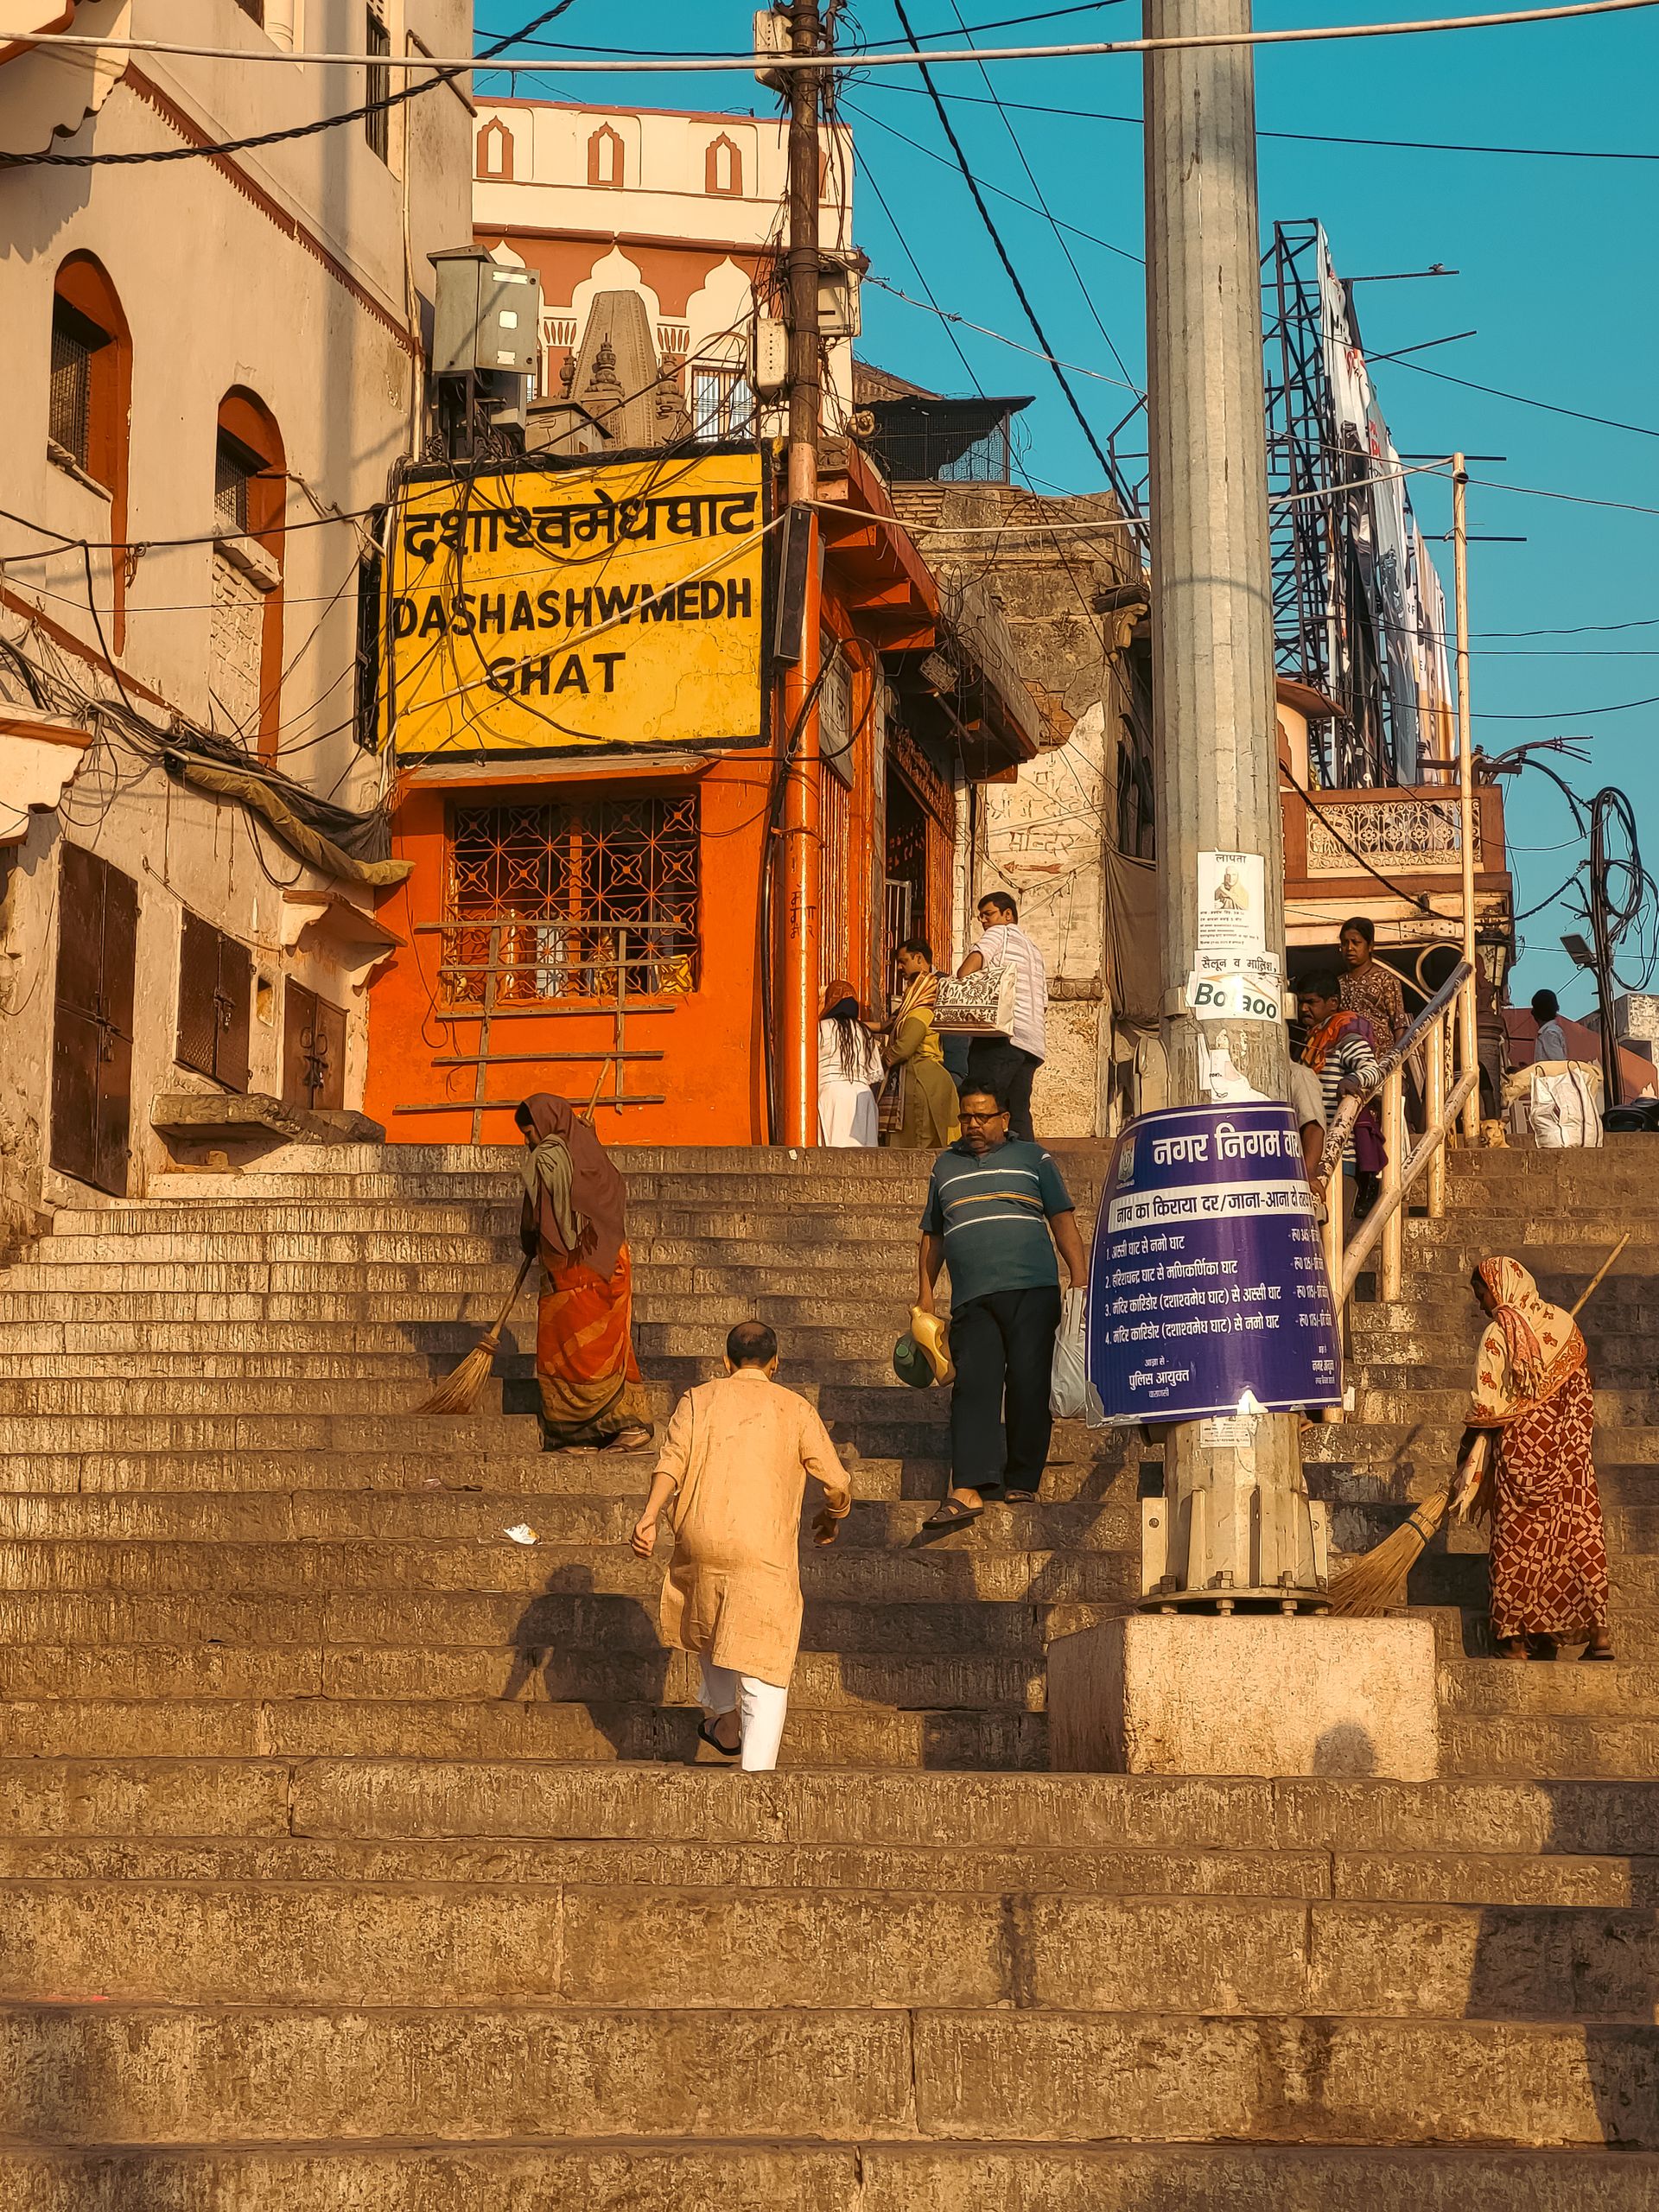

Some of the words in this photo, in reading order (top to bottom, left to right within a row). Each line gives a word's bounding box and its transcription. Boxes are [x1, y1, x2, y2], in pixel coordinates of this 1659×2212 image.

[393, 578, 752, 639] DASHASHWMEDH
[486, 652, 626, 696] GHAT
[1215, 854, 1247, 864] लापता
[1201, 956, 1227, 971] सैलून
[1233, 958, 1241, 968] व
[1153, 1135, 1209, 1165] नगर
[1214, 1122, 1281, 1160] निगम
[1116, 1206, 1133, 1223] नाव
[1135, 1204, 1149, 1219] का
[1153, 1196, 1197, 1217] किराया
[1106, 1248, 1110, 1261] 1.
[1111, 1239, 1127, 1259] अस्सी
[1128, 1242, 1140, 1256] घाट
[1141, 1236, 1149, 1254] से
[1150, 1233, 1167, 1252] नमो
[1169, 1236, 1185, 1250] घाट
[1105, 1276, 1111, 1288] 2.
[1141, 1268, 1155, 1282] घाट
[1157, 1262, 1164, 1280] से
[1166, 1258, 1218, 1279] मणिकर्णिका
[1221, 1261, 1237, 1274] घाट
[1105, 1304, 1111, 1317] 3.
[1113, 1297, 1128, 1315] मंदिर
[1207, 1287, 1229, 1305] घाट)
[1231, 1285, 1240, 1302] से
[1243, 1282, 1266, 1301] अस्सी
[1268, 1286, 1281, 1300] घाट
[1105, 1332, 1111, 1344] 4.
[1113, 1325, 1128, 1344] मंदिर
[1210, 1317, 1231, 1333] घाट)
[1234, 1313, 1243, 1331] से
[1244, 1312, 1263, 1330] नमो
[1265, 1315, 1279, 1329] घाट
[1128, 1370, 1154, 1391] पुलिस
[1156, 1370, 1190, 1387] आयुक्त
